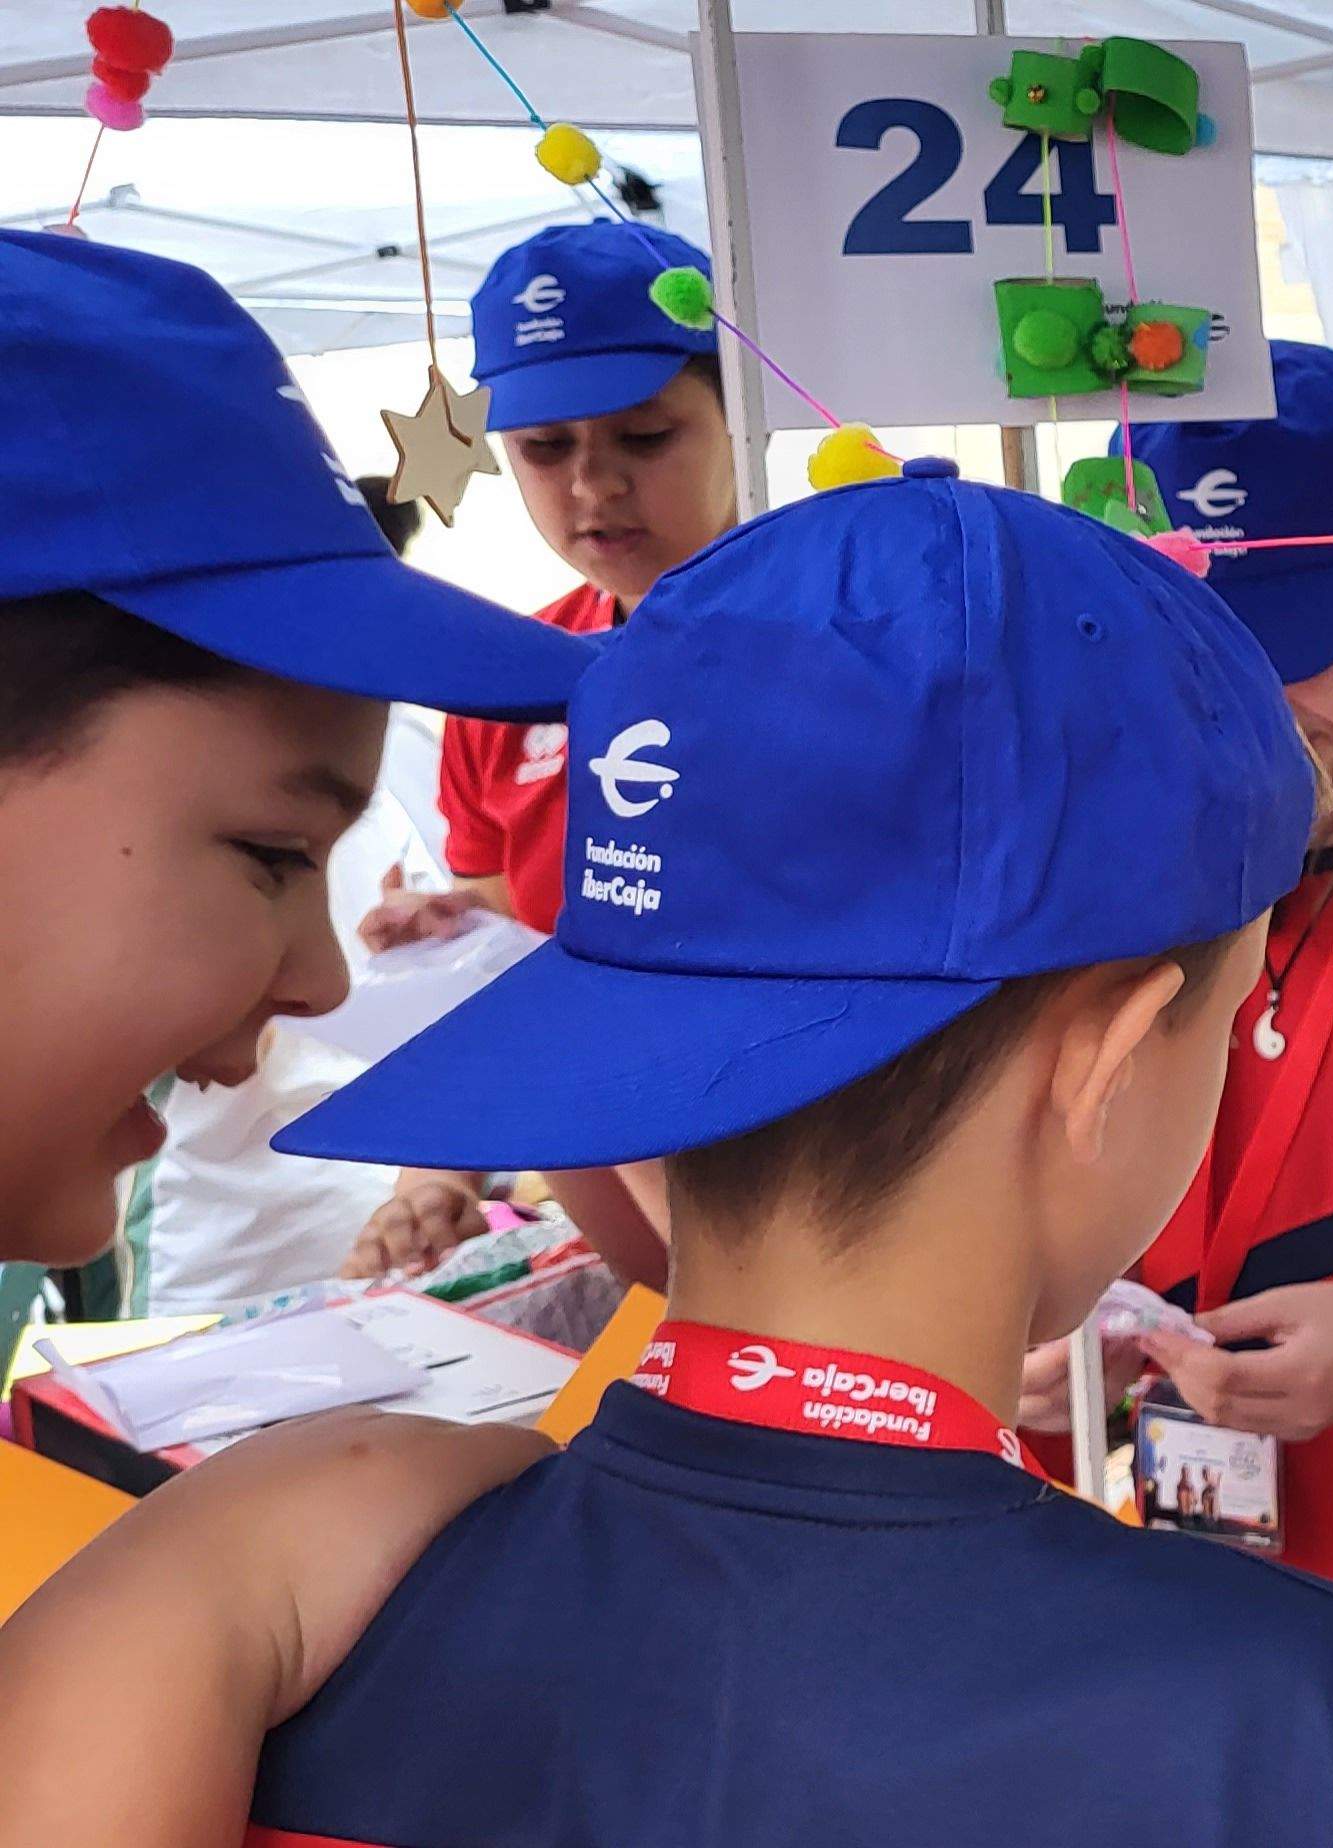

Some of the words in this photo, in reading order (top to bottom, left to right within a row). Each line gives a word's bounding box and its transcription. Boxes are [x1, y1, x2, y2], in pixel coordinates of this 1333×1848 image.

[836, 97, 1117, 256] 24
[586, 836, 662, 873] Fundación
[581, 868, 662, 916] iberCaja
[802, 1363, 938, 1417] iberCaja
[802, 1401, 932, 1442] Fundación
